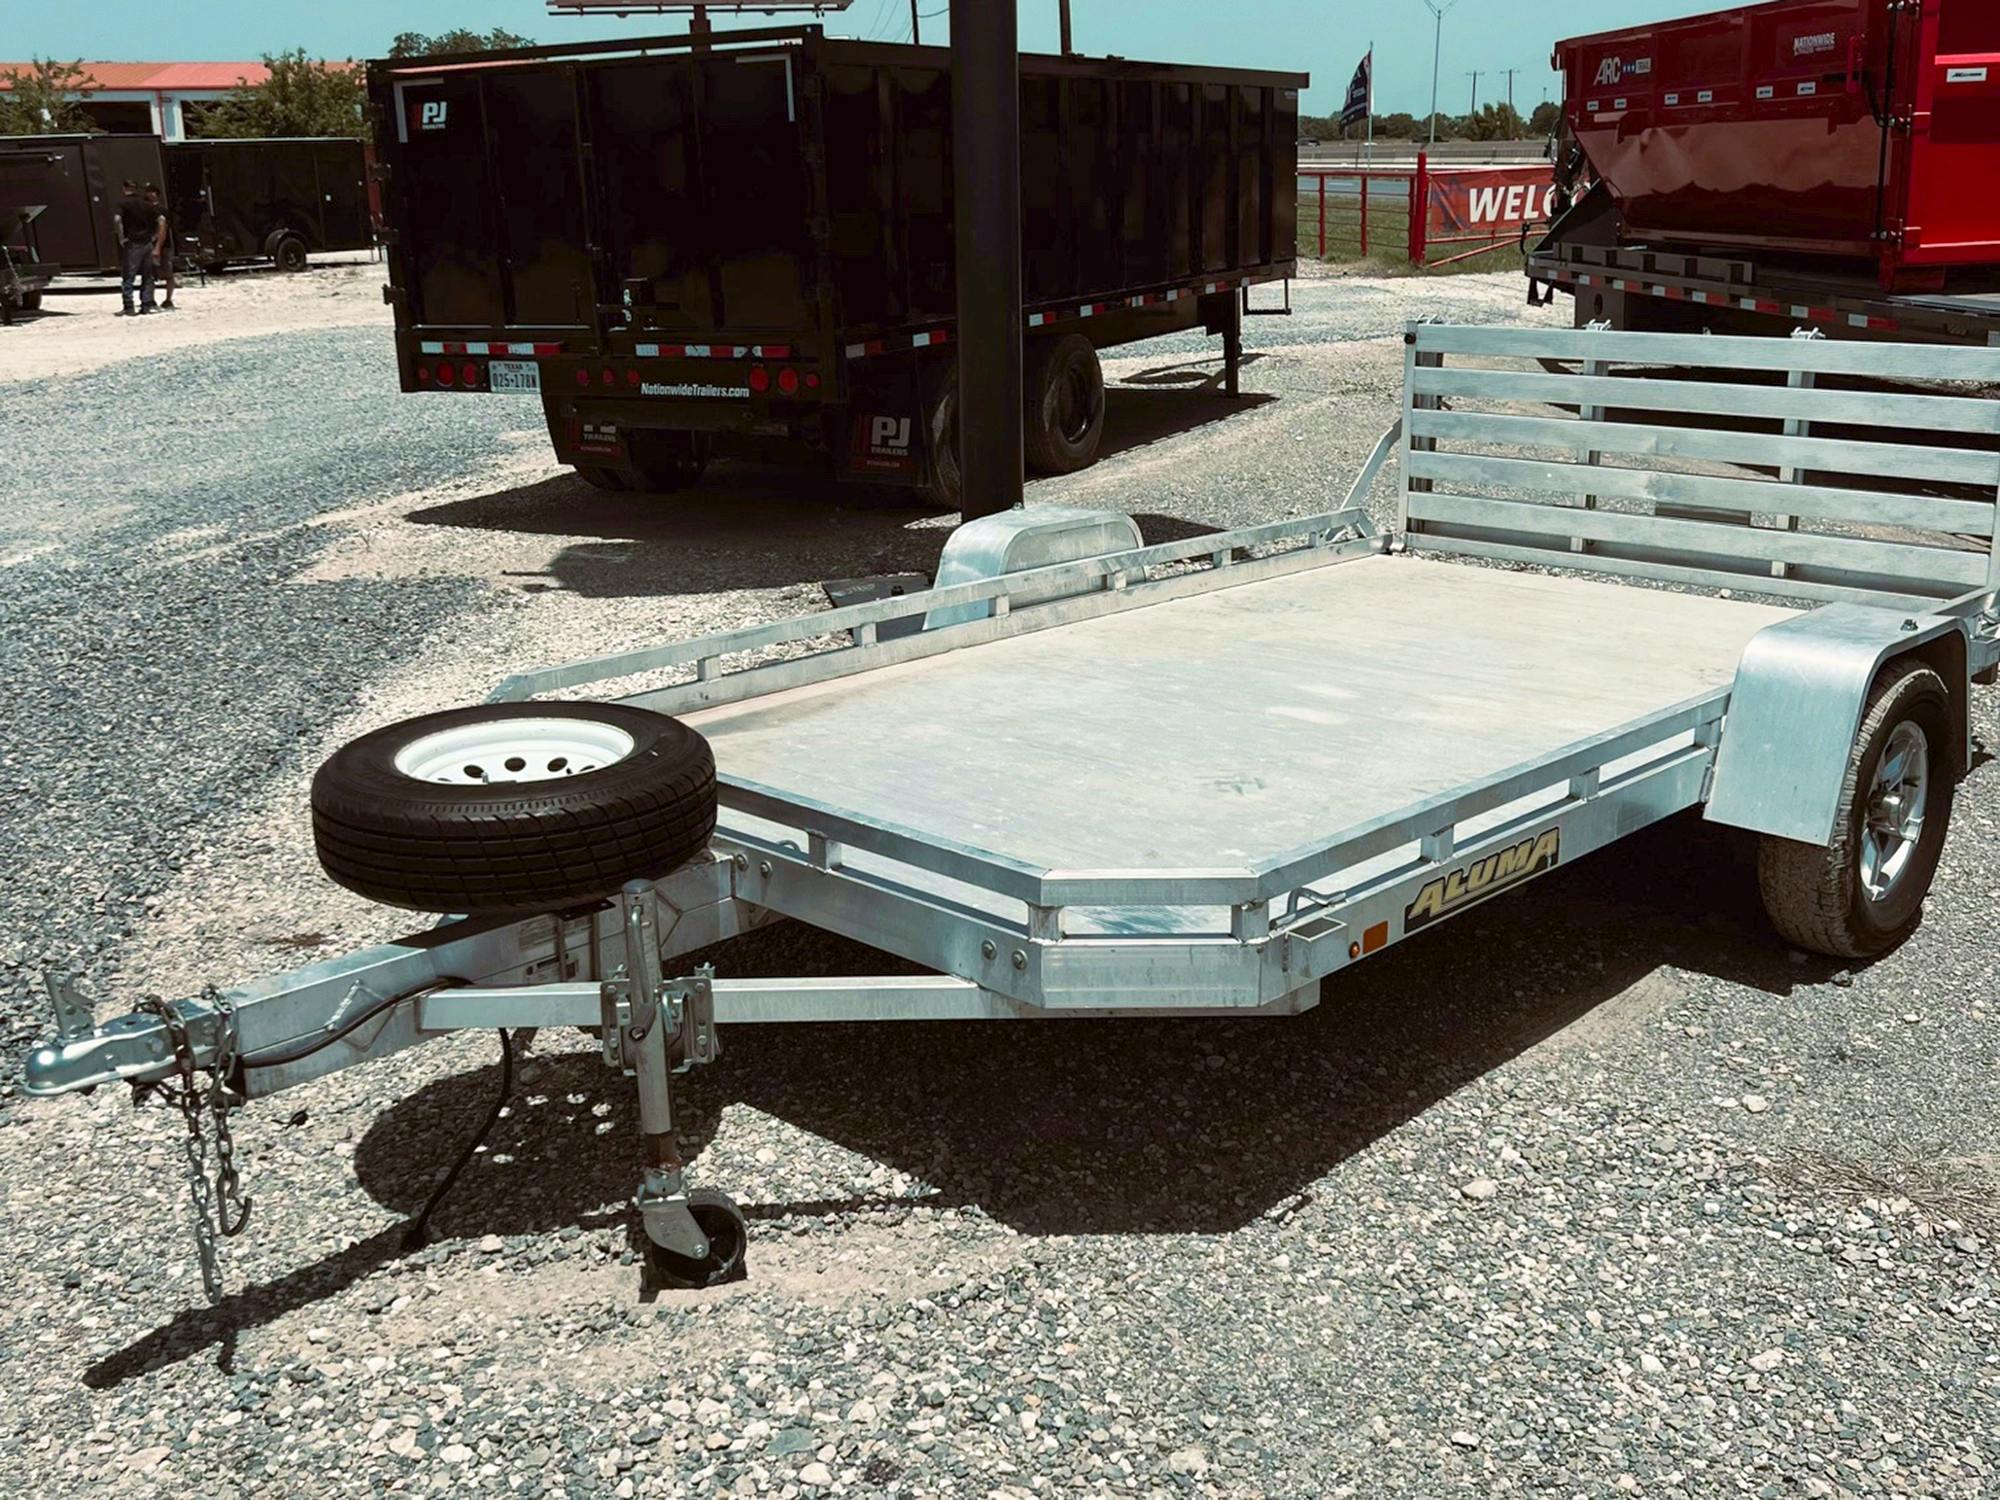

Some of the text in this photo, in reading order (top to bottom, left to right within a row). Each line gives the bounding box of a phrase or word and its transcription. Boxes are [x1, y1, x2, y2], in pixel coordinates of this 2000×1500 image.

[1593, 56, 1621, 85] ARC
[422, 101, 448, 124] PJ
[640, 382, 750, 398] NationwideTrailers.com
[871, 415, 911, 448] PJ
[1406, 827, 1560, 921] ALUMA
